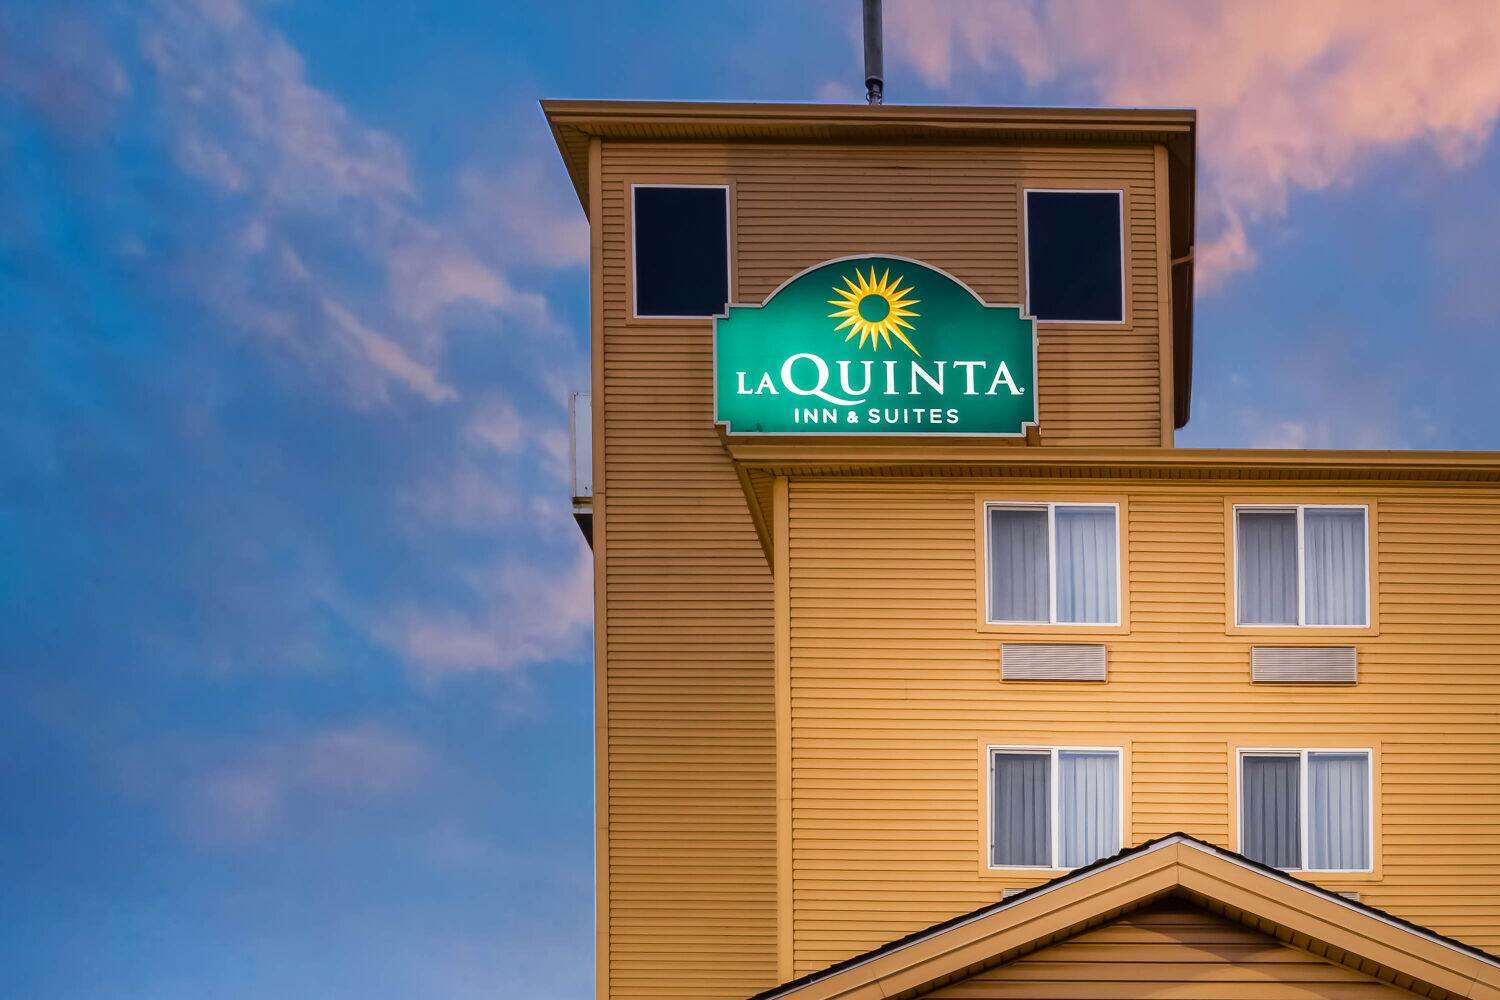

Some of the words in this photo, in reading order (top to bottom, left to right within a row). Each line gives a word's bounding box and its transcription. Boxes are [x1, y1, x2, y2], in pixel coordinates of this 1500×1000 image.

[736, 371, 780, 395] LA
[780, 352, 1022, 406] QUINTA
[794, 408, 838, 424] INN
[846, 410, 859, 424] &
[868, 408, 959, 424] SUITES
